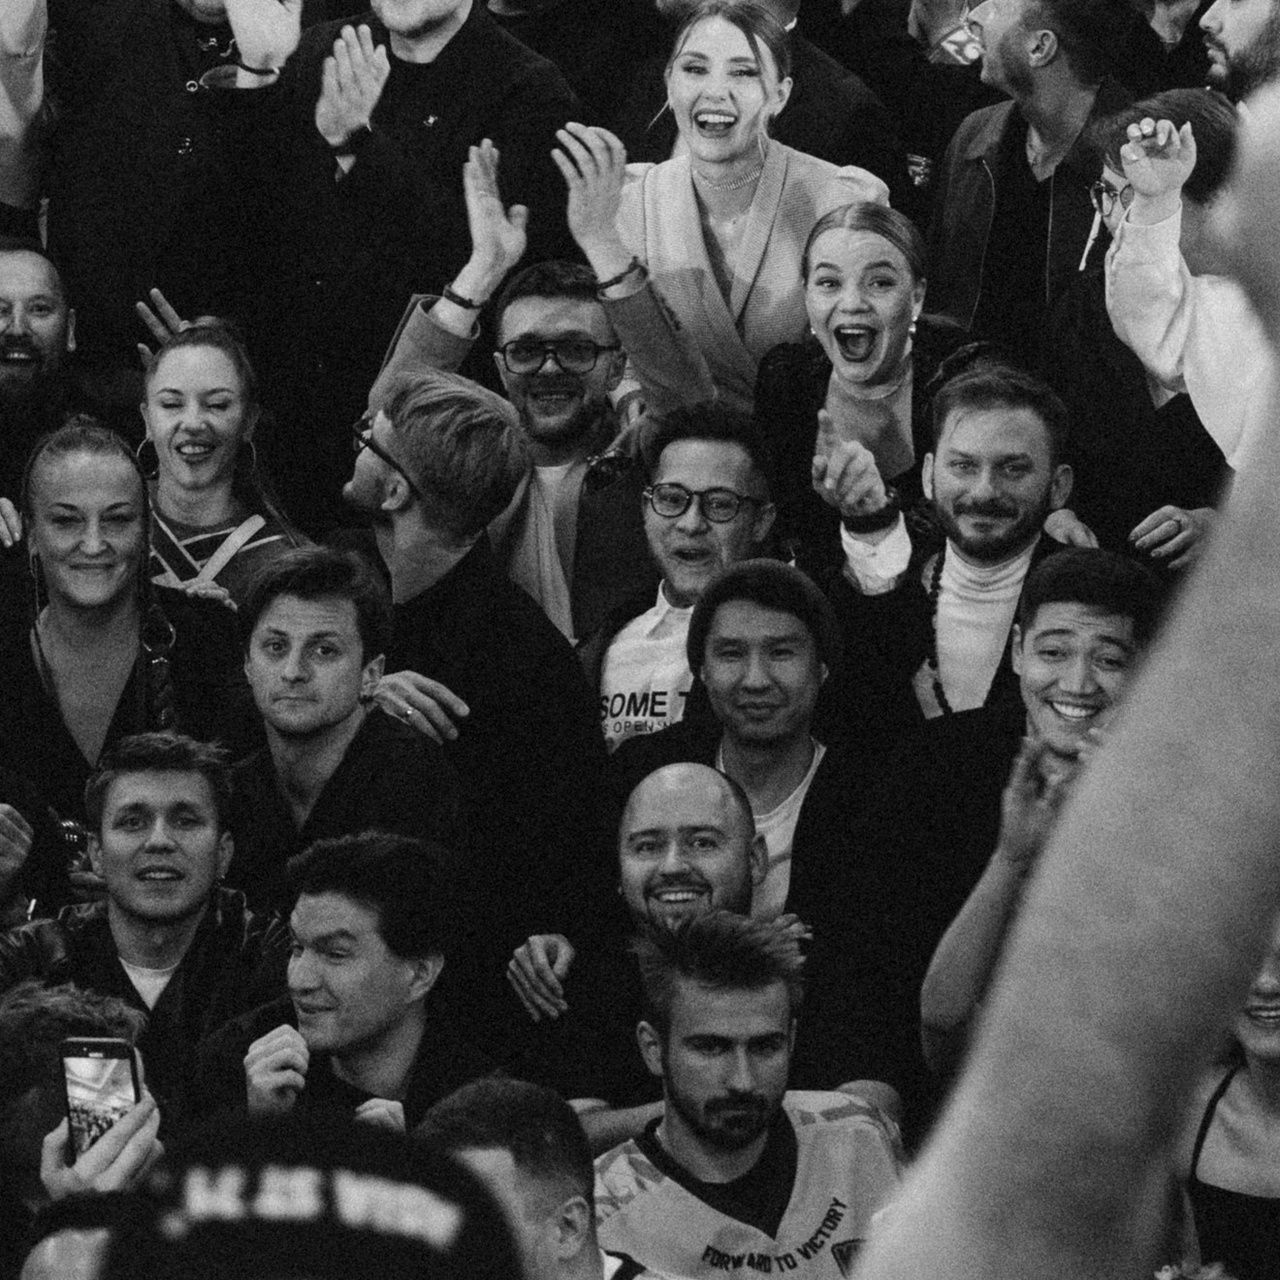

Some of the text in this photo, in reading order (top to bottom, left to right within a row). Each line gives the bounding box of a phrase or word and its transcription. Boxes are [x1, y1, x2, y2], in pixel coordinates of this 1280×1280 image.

[601, 690, 668, 721] SOME
[702, 1244, 772, 1274] FORWARD
[774, 1253, 798, 1273] TO
[796, 1197, 847, 1261] VICTORY
